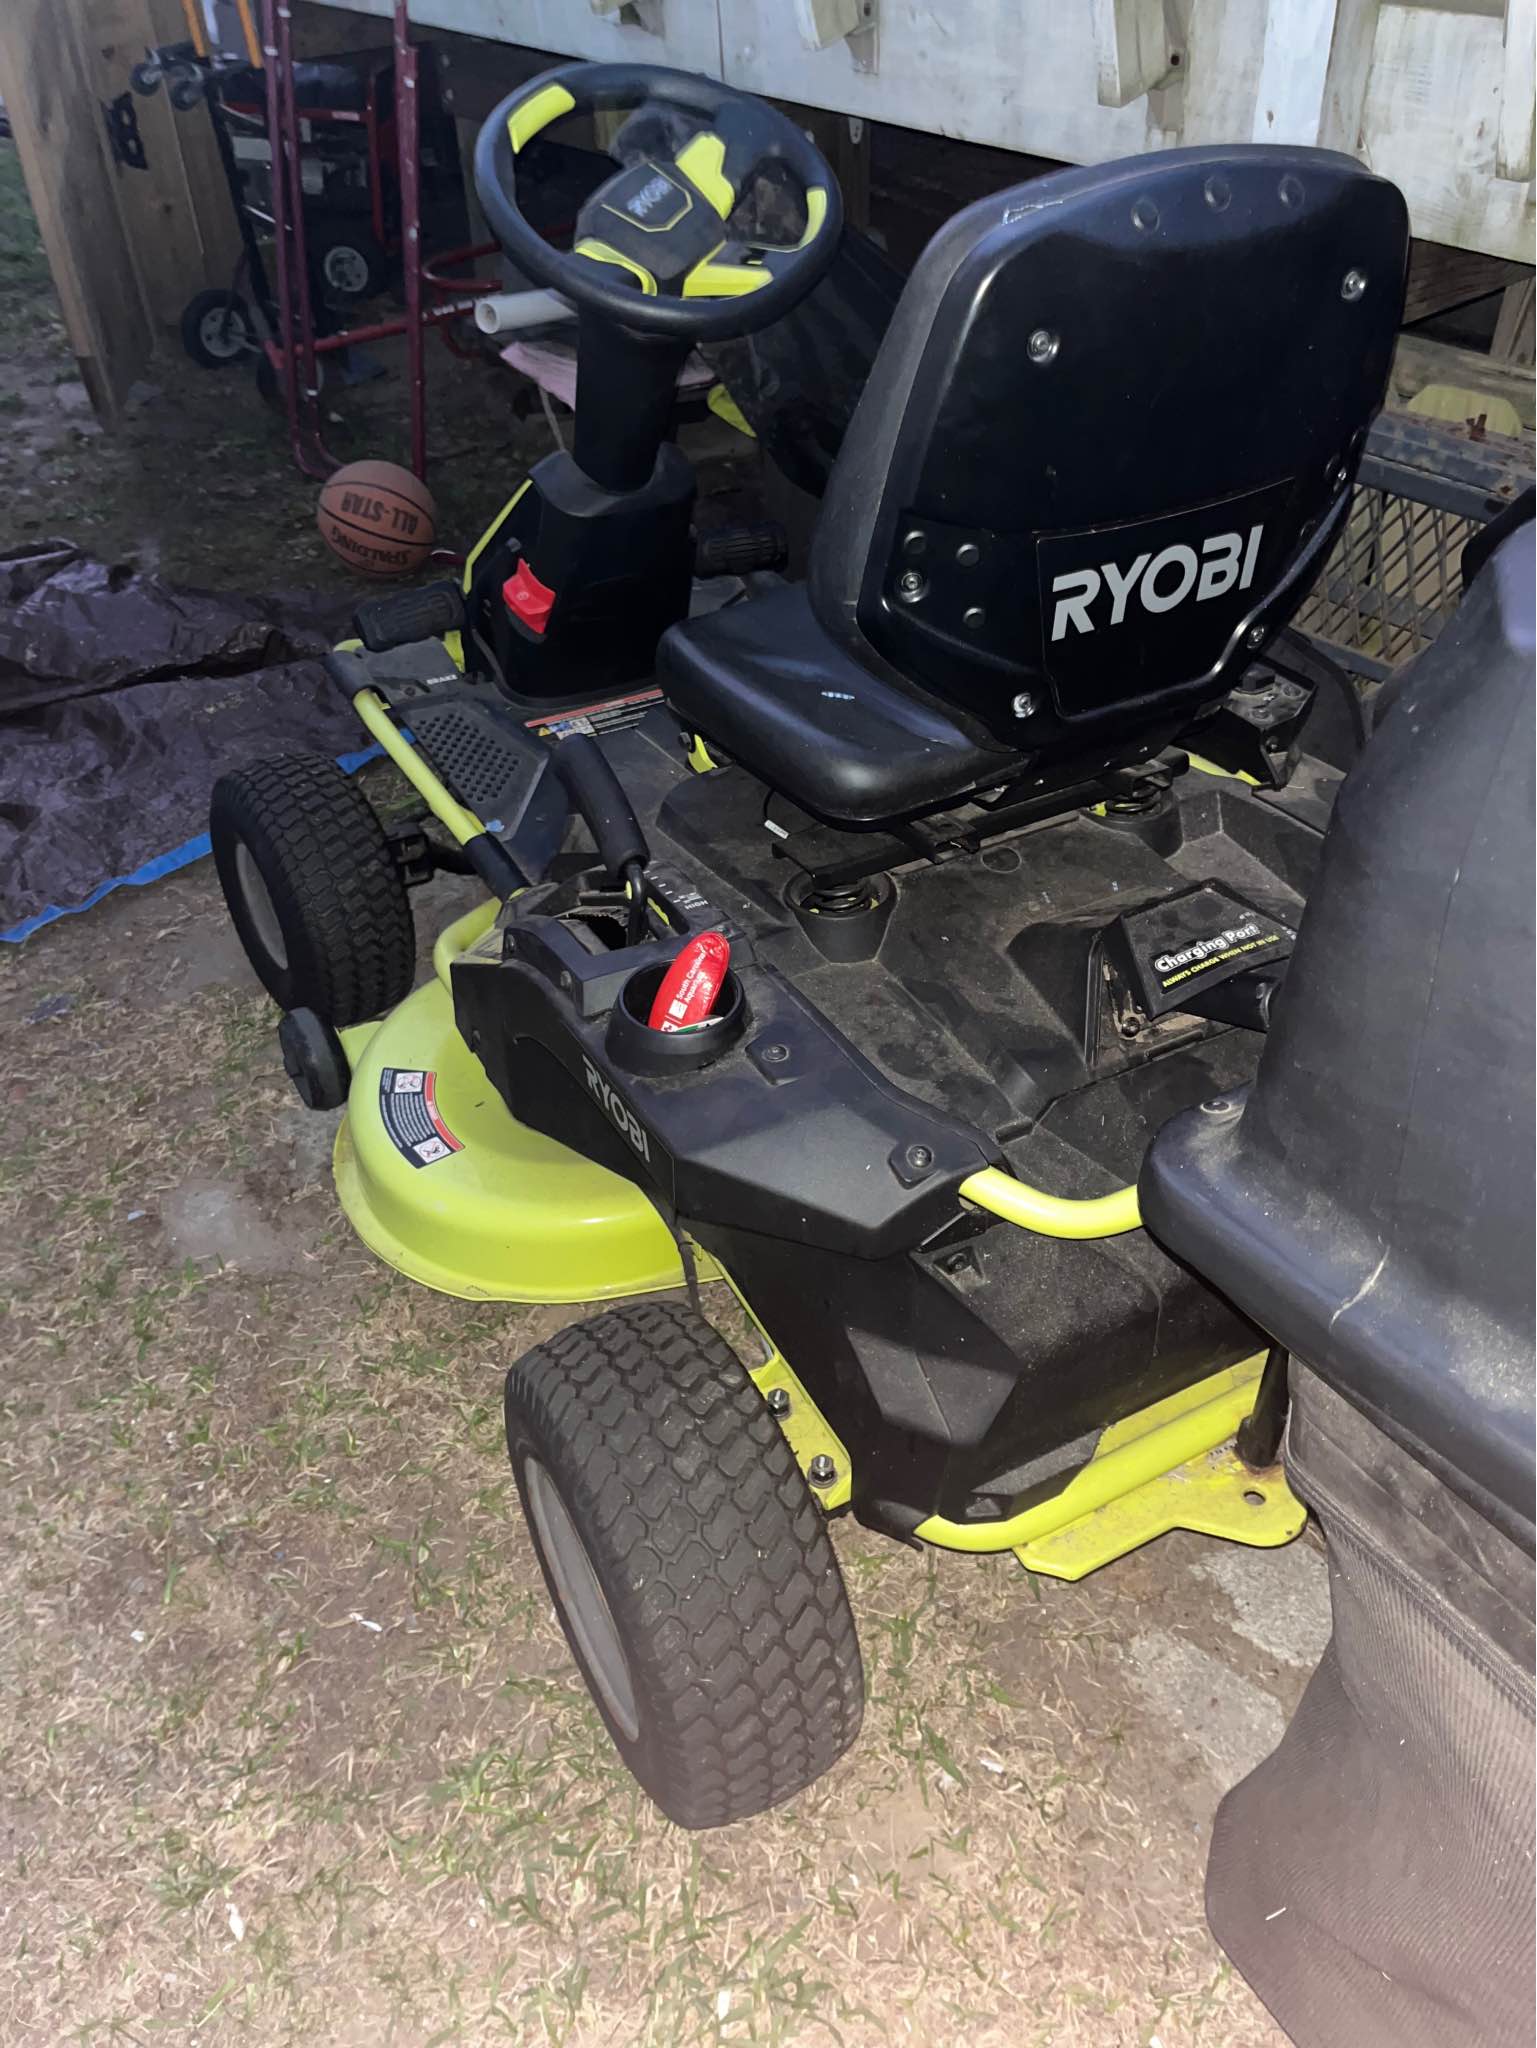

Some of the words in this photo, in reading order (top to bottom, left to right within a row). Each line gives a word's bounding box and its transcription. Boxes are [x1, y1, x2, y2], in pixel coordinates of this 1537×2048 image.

[341, 491, 419, 535] ALL-STAR
[1051, 524, 1264, 641] RYOBI
[684, 900, 708, 909] HIGH
[1155, 936, 1228, 972] Charging
[1222, 923, 1260, 943] Port
[1162, 969, 1192, 987] ALWAYS
[1191, 956, 1220, 973] CHARGE
[1219, 947, 1242, 960] WHEN
[1240, 940, 1258, 952] NOT
[676, 977, 690, 1000] South
[582, 1054, 650, 1162] RYOBI
